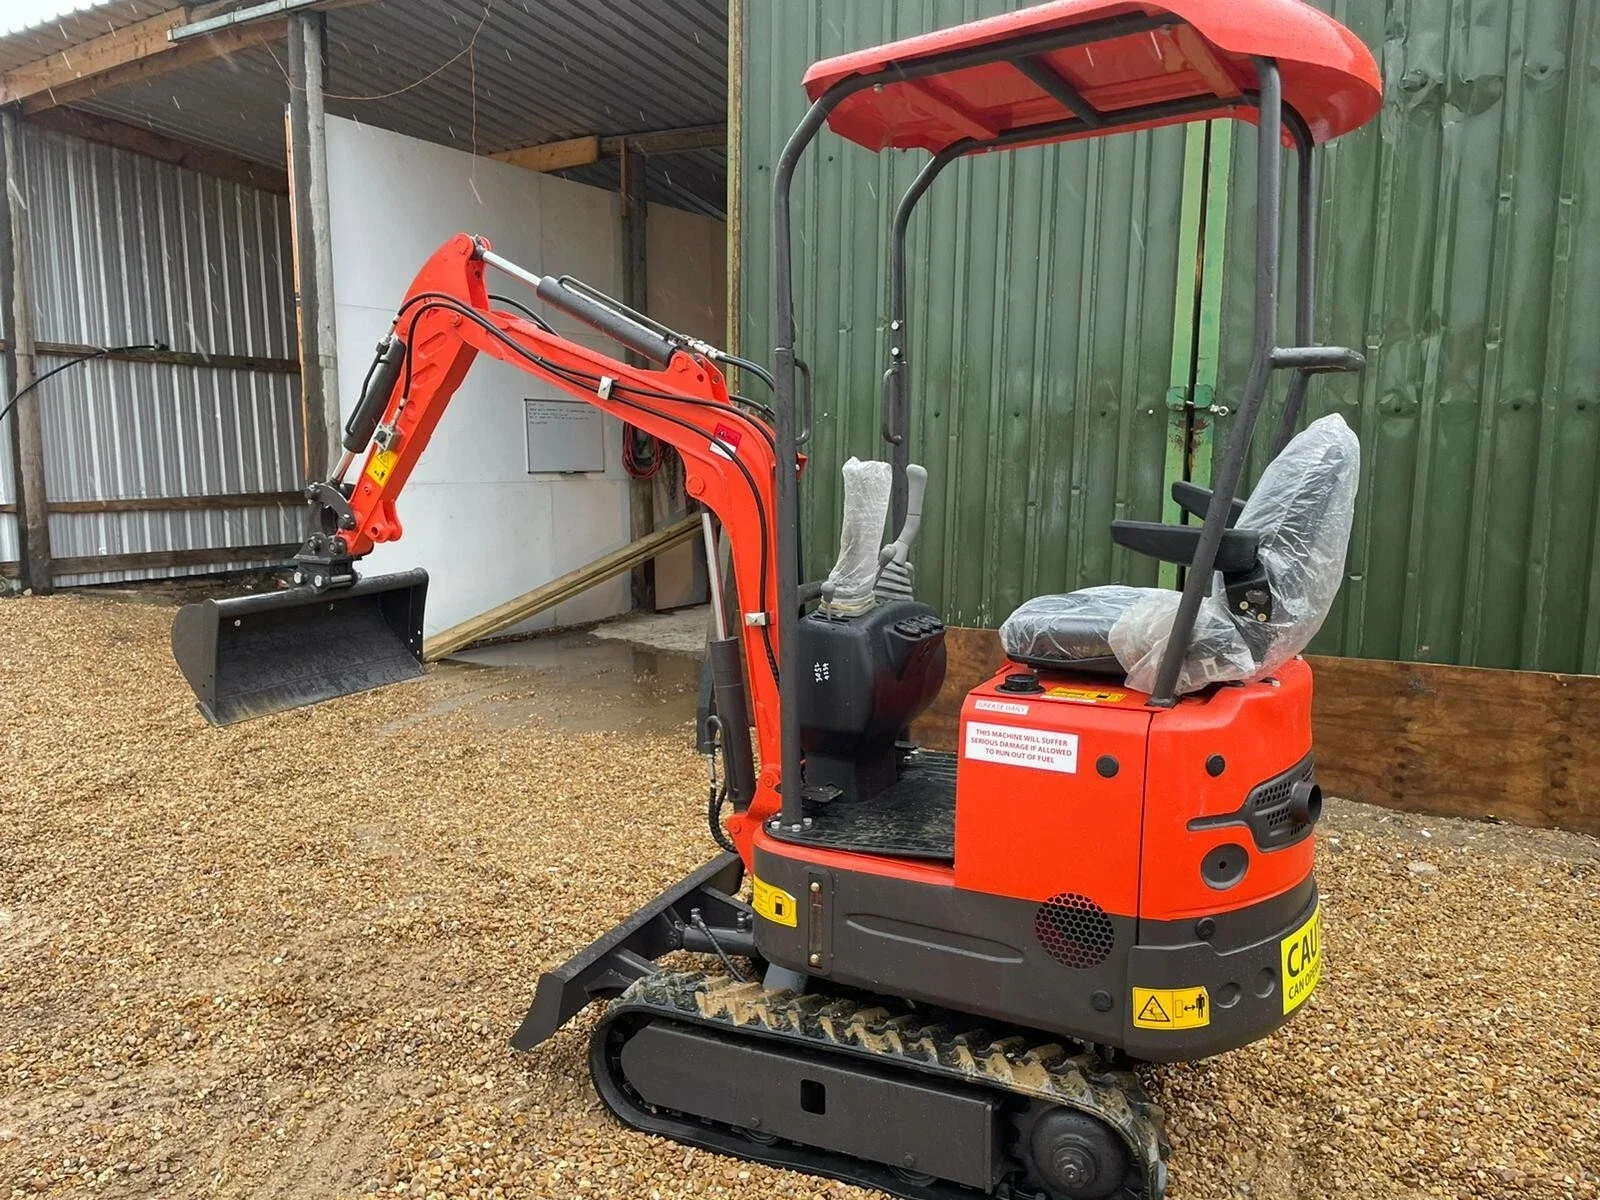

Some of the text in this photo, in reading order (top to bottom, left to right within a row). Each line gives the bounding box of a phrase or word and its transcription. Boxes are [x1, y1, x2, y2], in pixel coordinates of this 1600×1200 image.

[978, 702, 1025, 713] GREASE DAILY
[970, 737, 998, 747] SERIOUS
[1000, 741, 1028, 751] DAMAGE
[1038, 746, 1072, 756] ALLOWED
[976, 728, 1068, 747] THIS MACHINE WILL SUFFER
[996, 749, 1010, 757] RUN
[1027, 753, 1036, 761] OF
[1037, 755, 1055, 764] FUEL
[1287, 915, 1319, 978] CAU
[1288, 978, 1304, 1000] CAN
